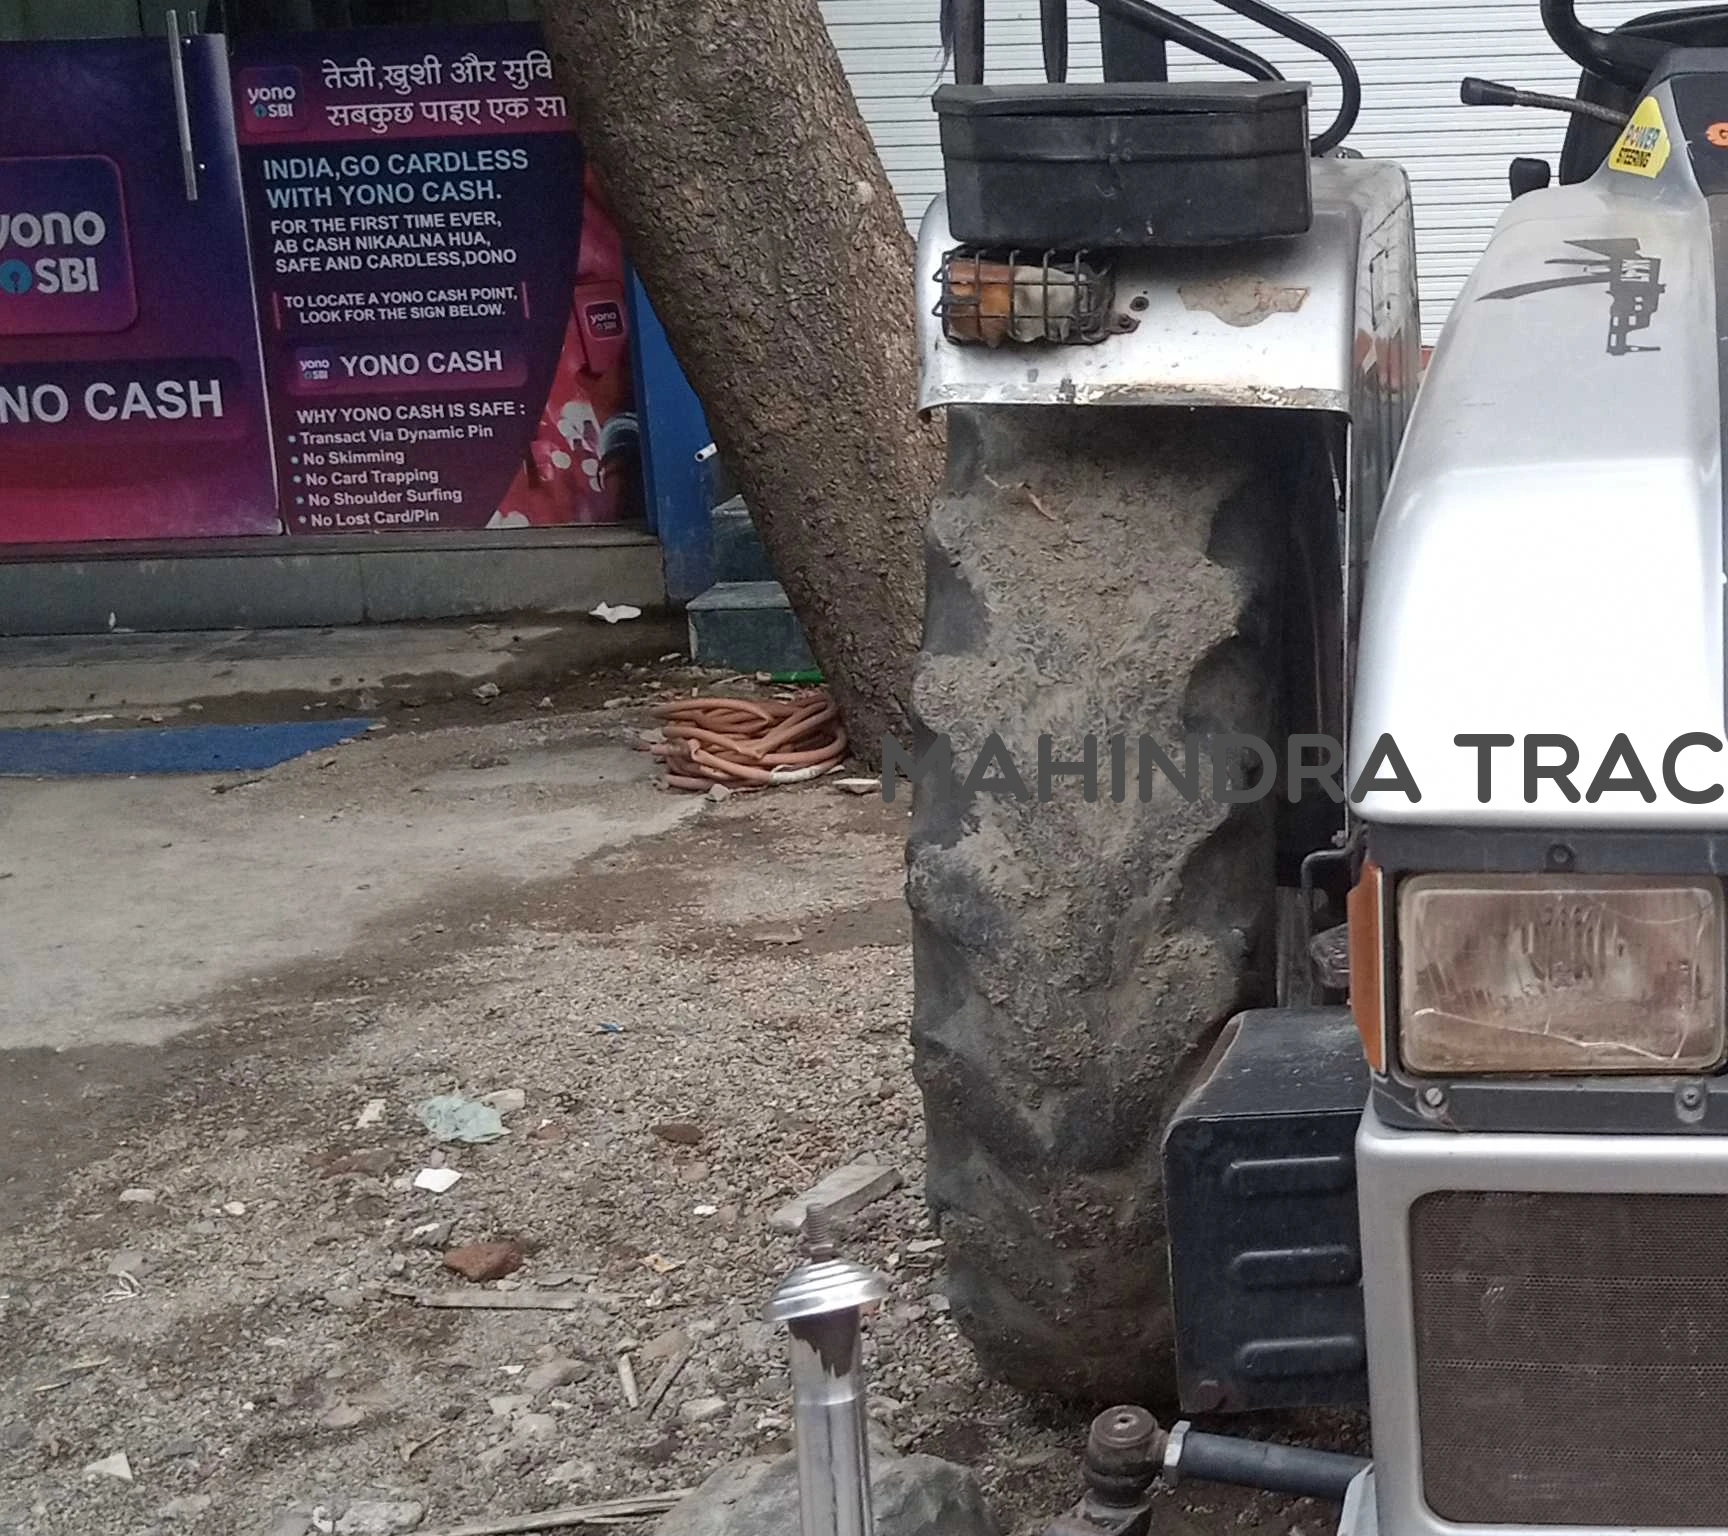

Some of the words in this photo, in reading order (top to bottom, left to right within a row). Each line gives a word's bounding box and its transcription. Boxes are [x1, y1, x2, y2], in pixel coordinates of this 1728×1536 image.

[450, 52, 496, 83] और
[247, 85, 296, 105] yono
[268, 104, 294, 118] SBI
[327, 101, 413, 133] सबकुछ
[419, 98, 482, 125] पाइए
[486, 97, 529, 124] एक
[387, 148, 529, 175] CARDLESS
[266, 186, 332, 209] WITH
[337, 183, 414, 207] YONO
[421, 180, 502, 203] CASH.
[271, 218, 307, 234] FOR
[310, 216, 346, 233] THE
[350, 215, 400, 231] FIRST
[403, 213, 444, 229] TIME
[450, 211, 502, 228] EVER,
[274, 239, 298, 254] AB
[302, 235, 351, 252] CASH
[355, 232, 443, 249] NIKAALNA
[448, 230, 491, 247] HUA,
[275, 257, 322, 273] SAFE
[325, 254, 362, 271] AND
[34, 257, 99, 294] SBI
[284, 296, 304, 309] TO
[307, 292, 365, 307] LOCATE
[368, 291, 379, 304] A
[380, 290, 423, 304] YONO
[426, 288, 468, 303] CASH
[470, 287, 518, 302] POINT,
[300, 309, 341, 324] LOOK
[344, 308, 375, 322] FOR
[378, 307, 408, 321] THE
[410, 306, 446, 320] SIGN
[449, 304, 506, 319] BELOW.
[299, 358, 330, 371] yono
[340, 353, 420, 378] YONO
[427, 350, 504, 373] CASH
[84, 379, 224, 421] CASH
[297, 409, 337, 424] WHY
[341, 406, 391, 422] YONO
[396, 404, 444, 420] CASH
[449, 403, 465, 418] IS
[469, 401, 516, 417] SAFE
[299, 430, 366, 445] Transact
[370, 429, 395, 443] Via
[398, 426, 465, 445] Dynamic
[468, 424, 493, 439] Pin
[303, 453, 325, 466] No
[329, 450, 405, 467] Skimming
[306, 473, 327, 486] No
[331, 470, 369, 485] Card
[373, 469, 439, 486] Trapping
[308, 494, 330, 507] No
[334, 490, 404, 506] Shoulder
[407, 488, 463, 505] Surfing
[311, 514, 332, 527] No
[336, 511, 370, 526] Lost
[374, 509, 440, 525] Card/Pin
